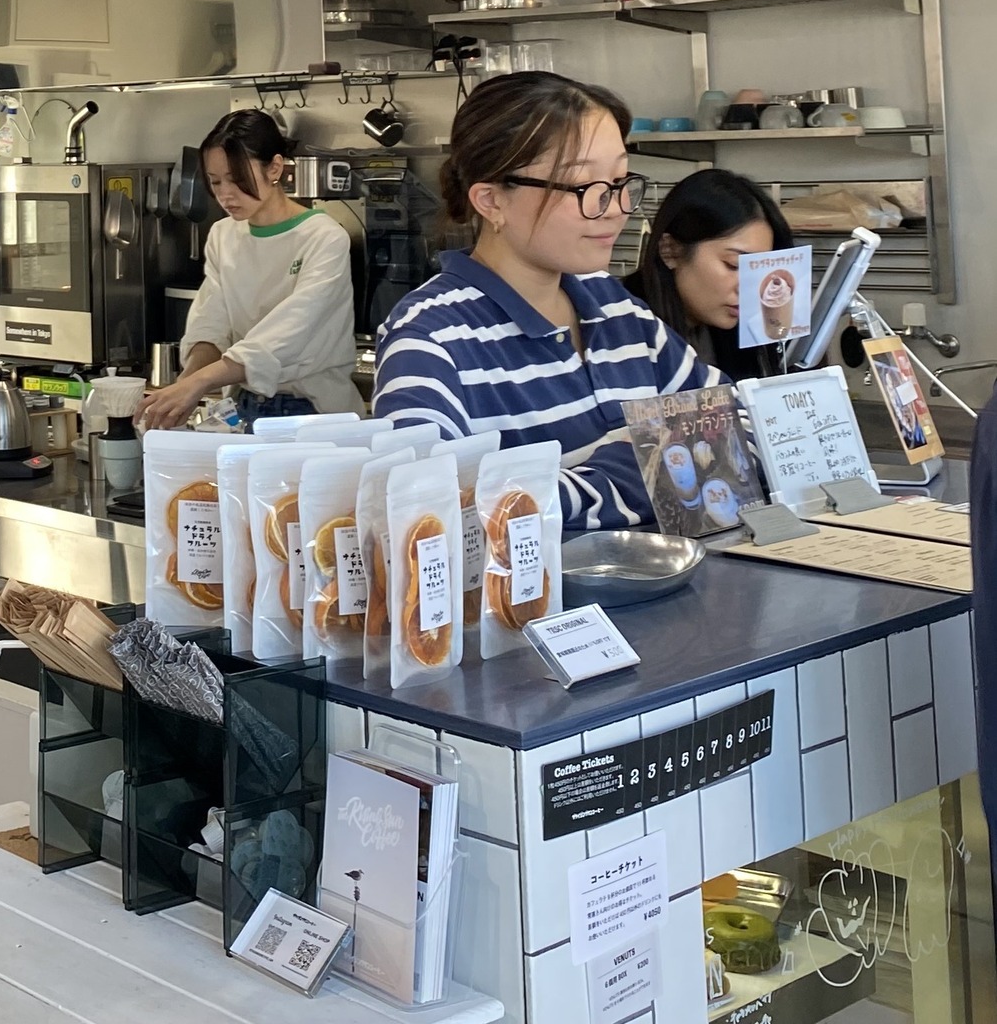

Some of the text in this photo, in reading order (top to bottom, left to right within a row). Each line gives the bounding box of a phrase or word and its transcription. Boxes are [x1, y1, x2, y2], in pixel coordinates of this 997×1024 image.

[37, 329, 51, 339] Tokyo
[701, 389, 731, 411] Latte
[782, 390, 816, 413] TODAY'S
[682, 412, 734, 436] モンブランラテ
[184, 524, 221, 533] ナチュラル
[192, 533, 213, 541] ドライ
[187, 540, 217, 548] フルーツ
[423, 562, 445, 574] ナチュラル
[428, 571, 442, 582] ドライ
[426, 579, 445, 589] フルーツ
[617, 715, 772, 789] 1 2 3 4 5 6 7 8 9 10 11
[554, 755, 615, 778] Coffee Tickets
[361, 822, 401, 852] Coffee
[590, 856, 643, 884] コーヒーチケット
